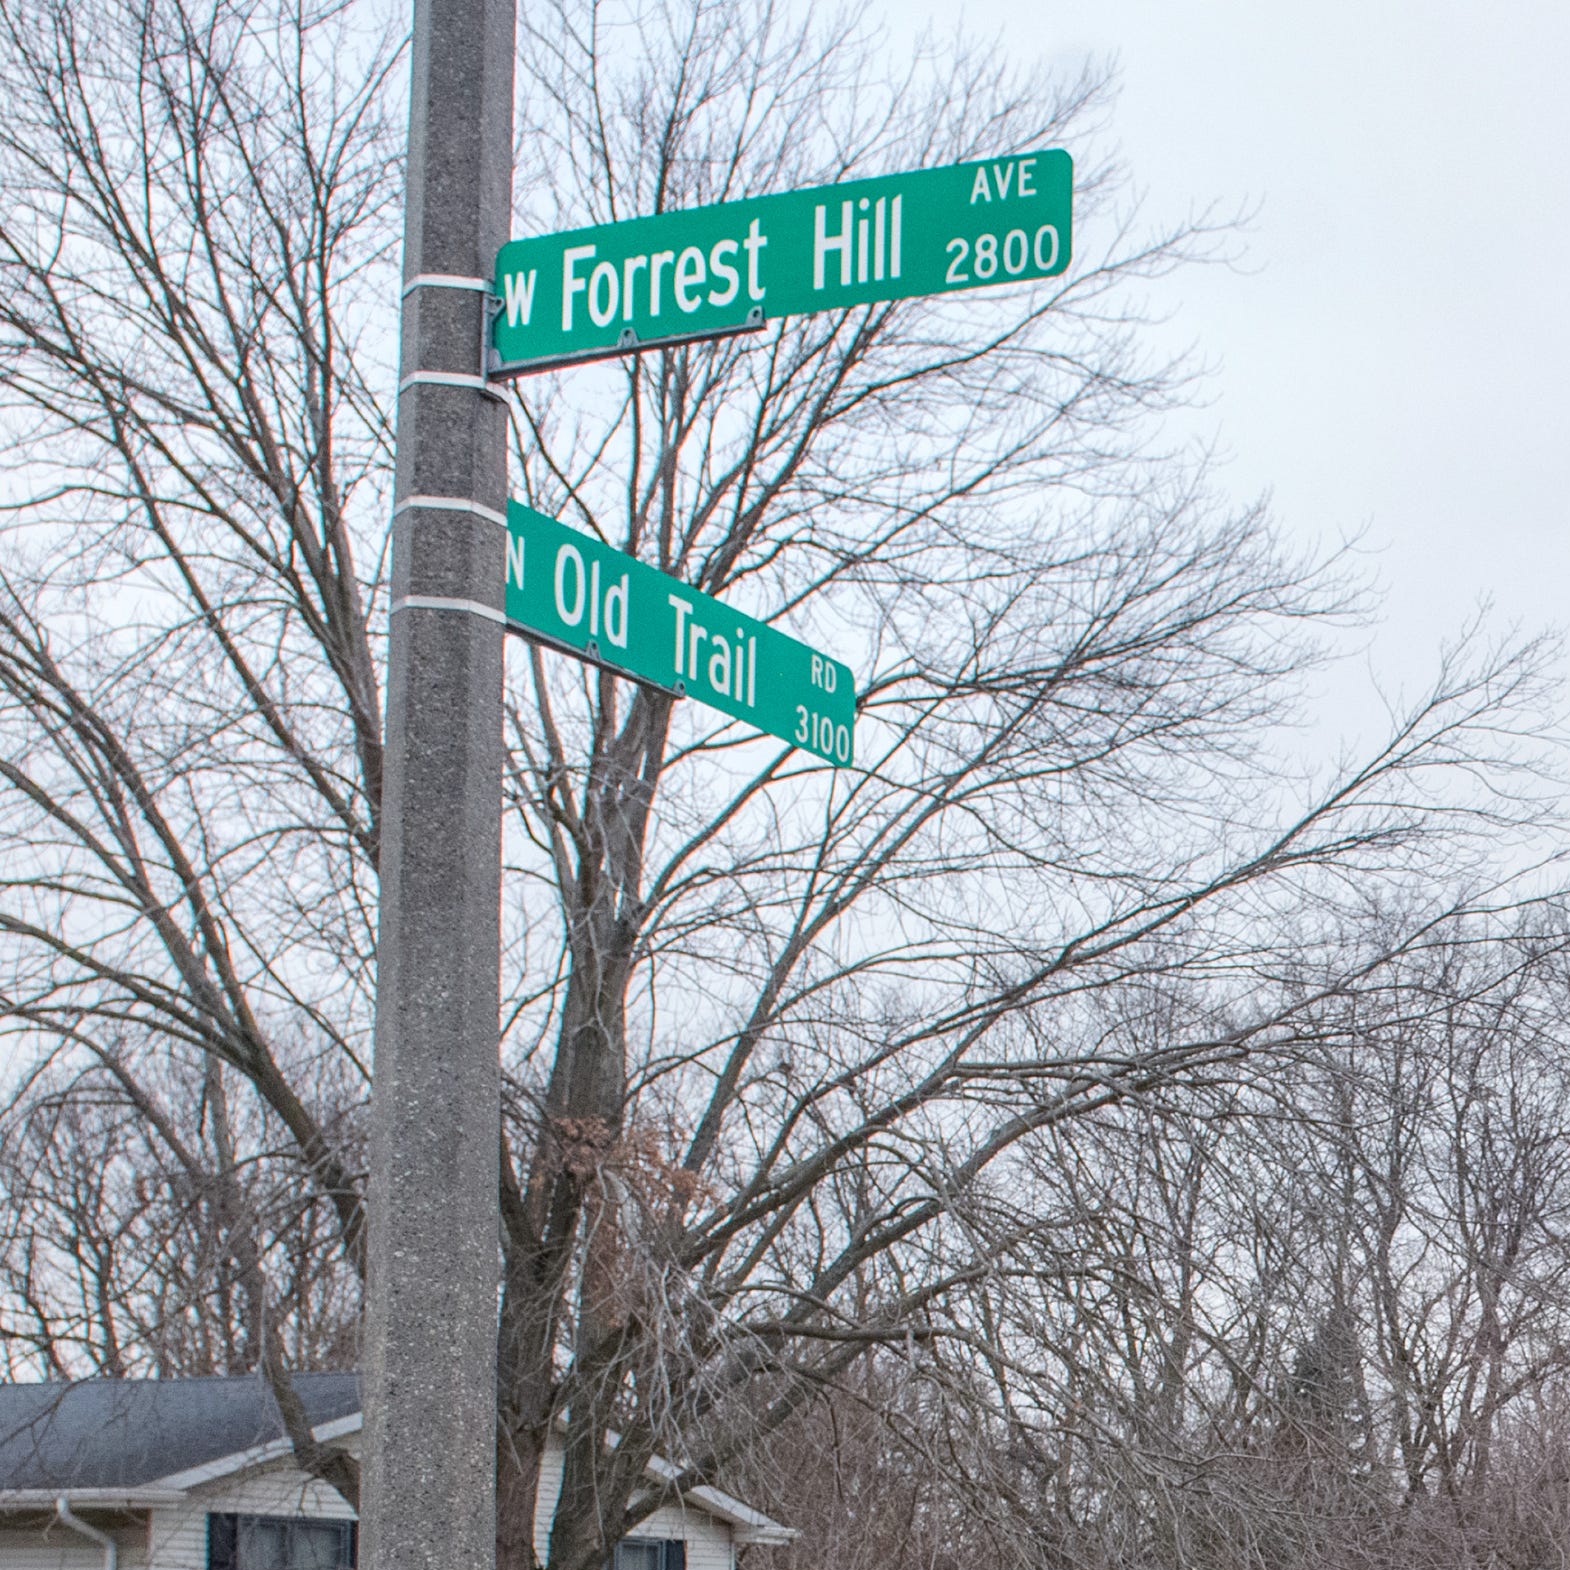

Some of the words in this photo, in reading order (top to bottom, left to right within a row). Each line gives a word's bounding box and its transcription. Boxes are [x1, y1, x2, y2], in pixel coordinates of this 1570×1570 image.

[970, 158, 1038, 204] AVE
[503, 269, 537, 328] W
[561, 217, 768, 332] Forrest
[813, 193, 902, 290] Hill
[945, 224, 1060, 284] 2800
[505, 529, 525, 590] N
[554, 543, 630, 649] Old
[668, 592, 757, 708] Trail
[811, 653, 837, 694] RD
[794, 704, 850, 764] 3100
